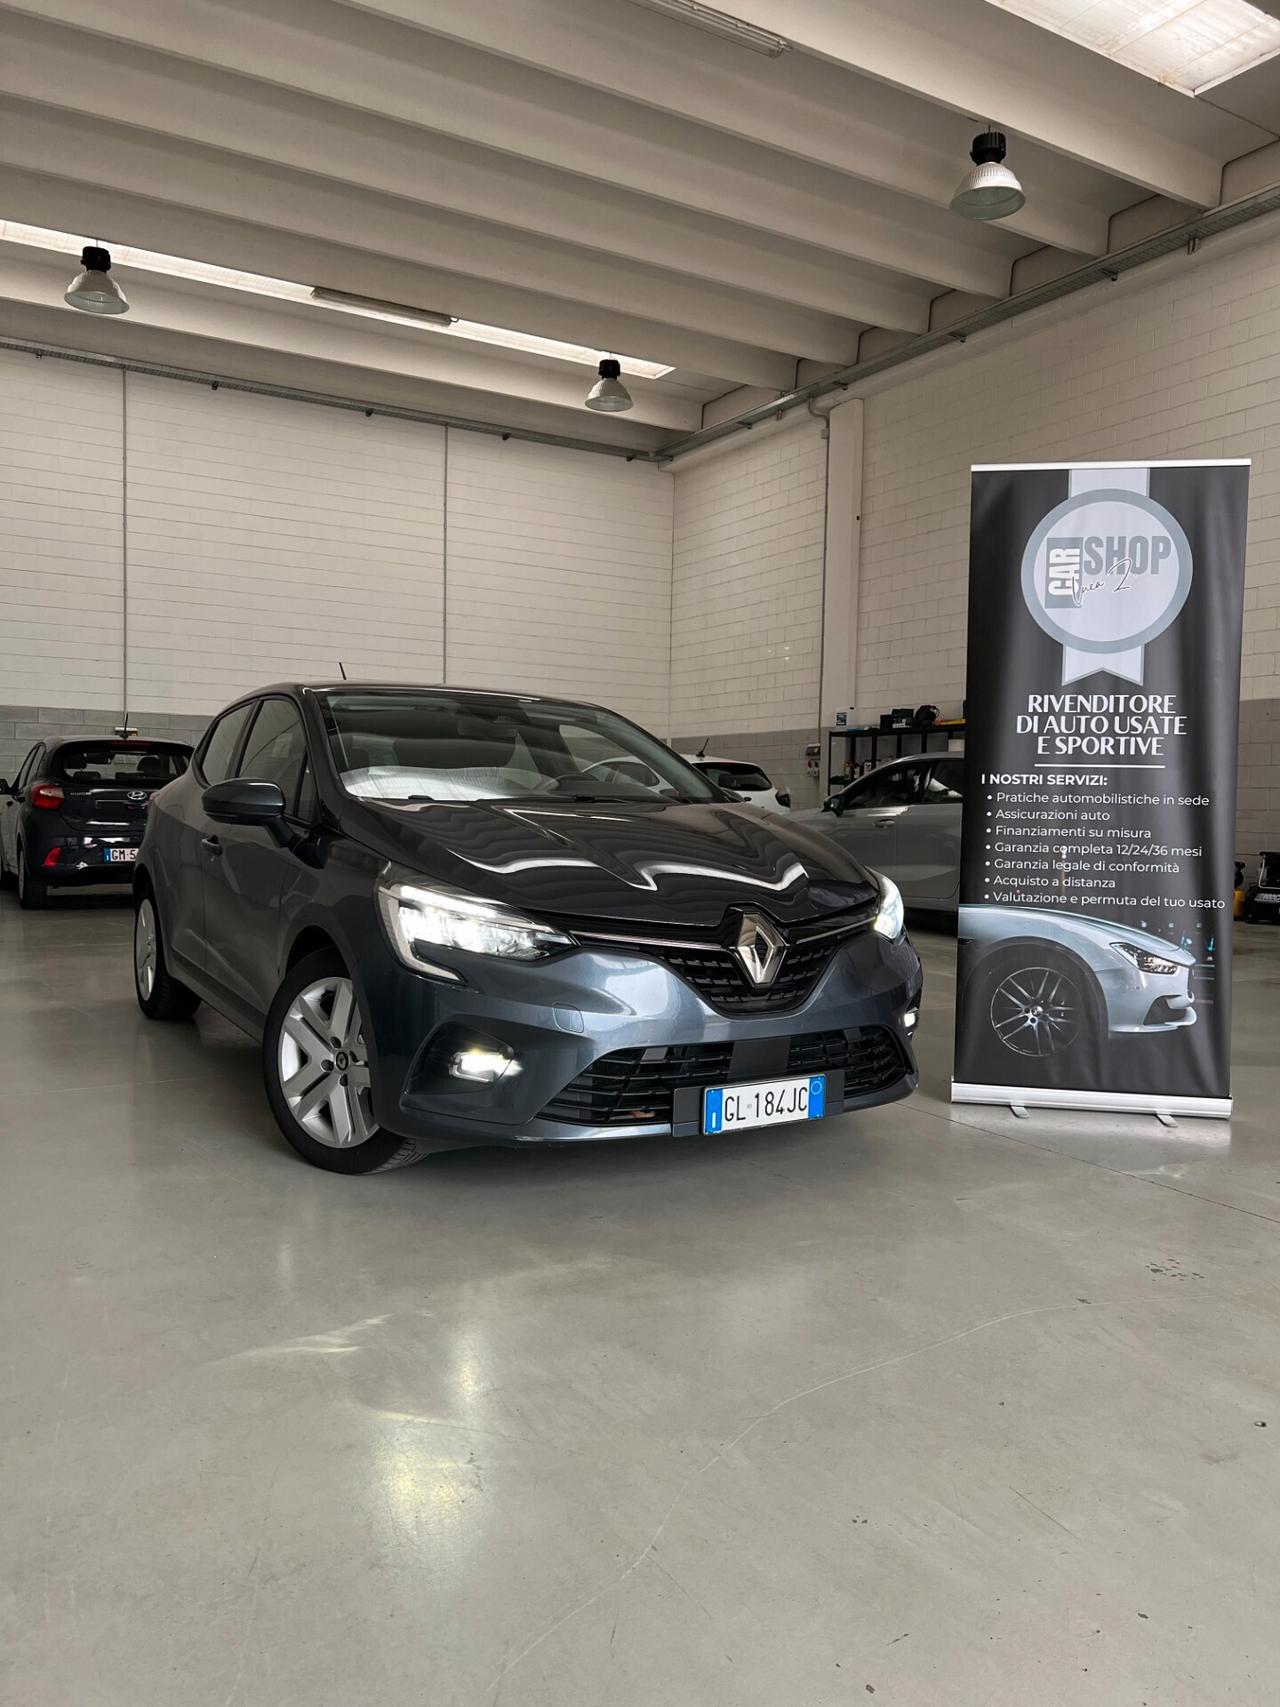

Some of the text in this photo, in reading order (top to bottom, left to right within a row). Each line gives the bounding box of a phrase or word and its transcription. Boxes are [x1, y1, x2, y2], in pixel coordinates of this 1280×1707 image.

[1083, 536, 1171, 575] SHOP
[1028, 694, 1177, 713] RIVENDITORE
[1016, 715, 1188, 735] DI AUTO USATE
[1037, 736, 1165, 756] E SPORTIVE
[981, 774, 1108, 786] I NOSTRI SERVIZI:
[996, 792, 1210, 806] Pratiche automobilistiche in sede
[995, 809, 1110, 820] Assicurazioni auto
[995, 825, 1152, 838] Finanziamenti su misura
[111, 849, 125, 860] GM
[994, 842, 1202, 857] Garanzia completa 12/24/36 mesi
[994, 858, 1180, 873] Garanzia legale di conformità
[993, 875, 1049, 887] Acquisto
[1062, 876, 1116, 888] distanza
[993, 891, 1226, 909] Valutazione e permuta del tuo usato
[724, 1087, 808, 1122] GL 184JC
